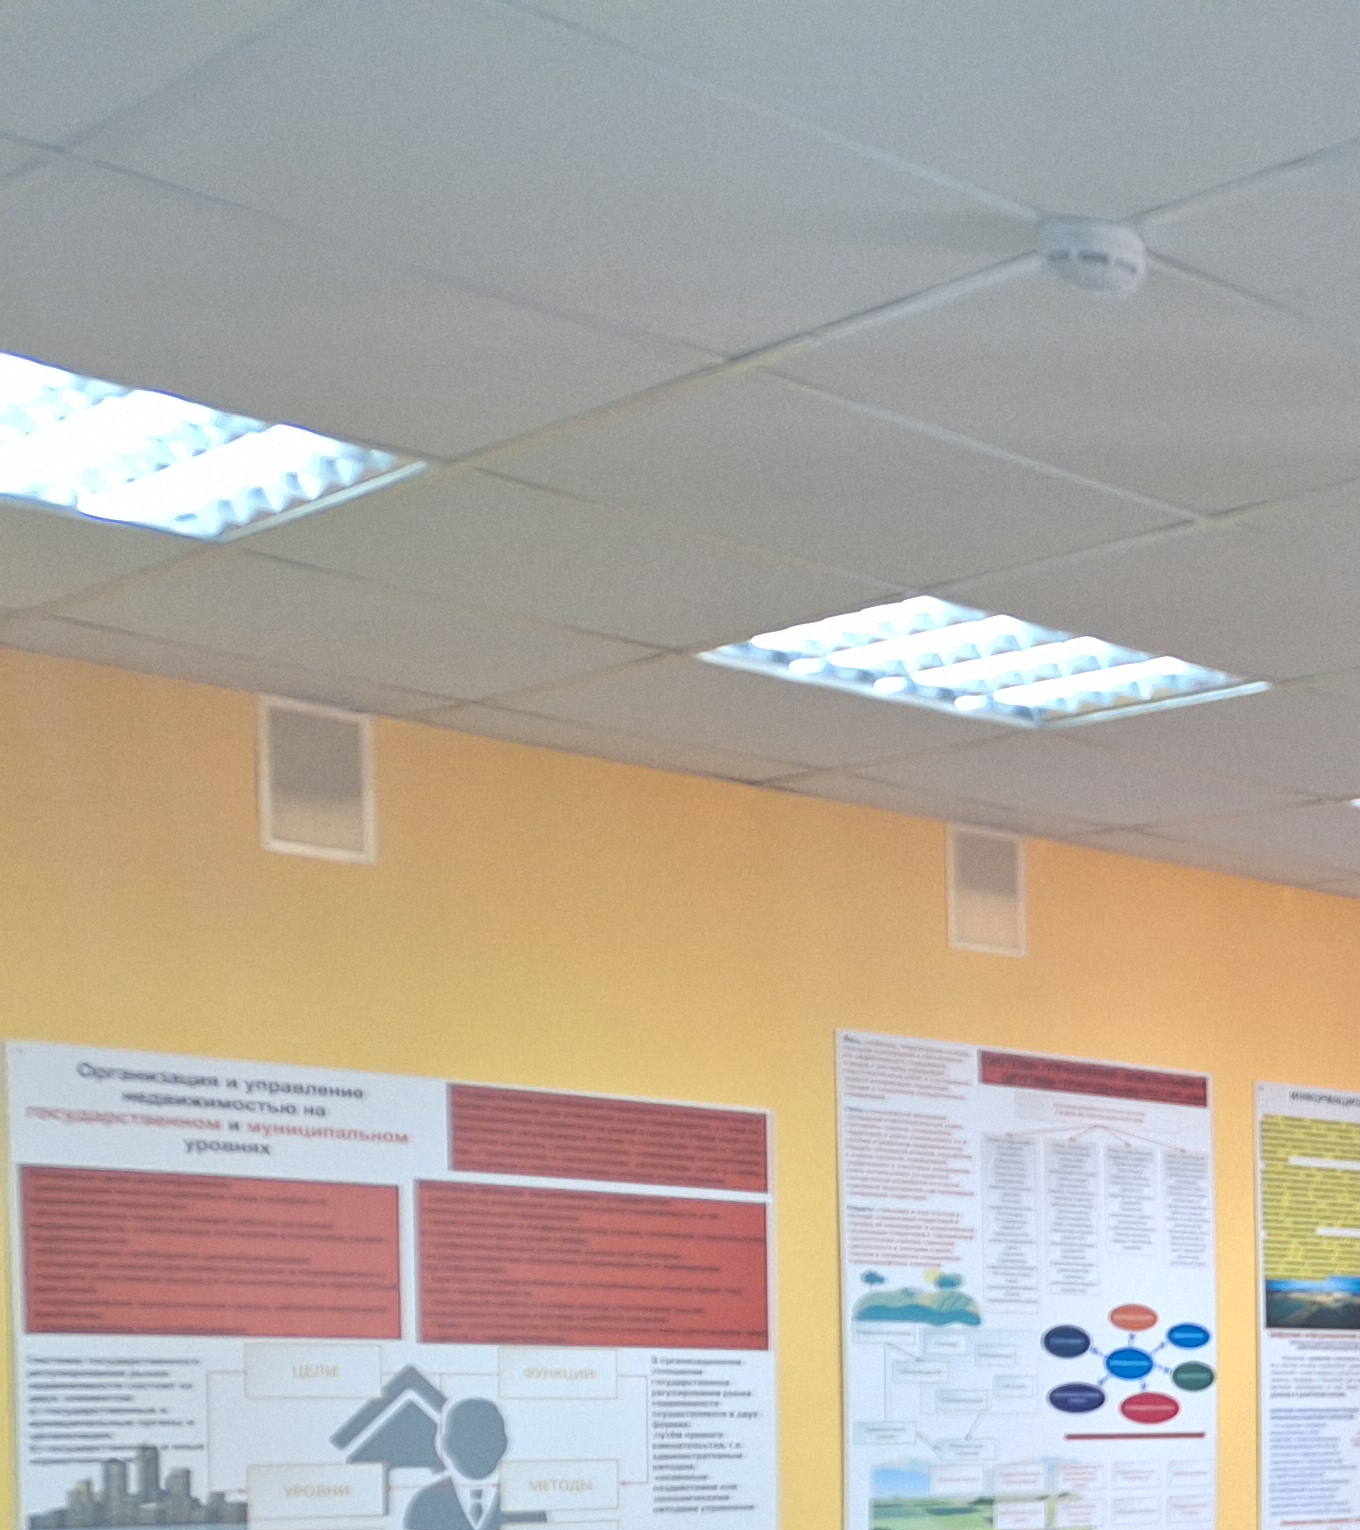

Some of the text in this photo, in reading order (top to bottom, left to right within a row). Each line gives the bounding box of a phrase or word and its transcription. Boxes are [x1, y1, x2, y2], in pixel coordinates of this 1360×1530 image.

[76, 1062, 365, 1099] Организация и управление
[121, 1091, 326, 1117] недвижимостью на
[26, 1106, 410, 1143] государственном и муниципальном
[183, 1138, 272, 1156] уровнях
[523, 1367, 596, 1380] ФУНКЦИИ
[283, 1484, 352, 1498] УРОВНИ
[528, 1478, 594, 1493] МЕТОДЫ
